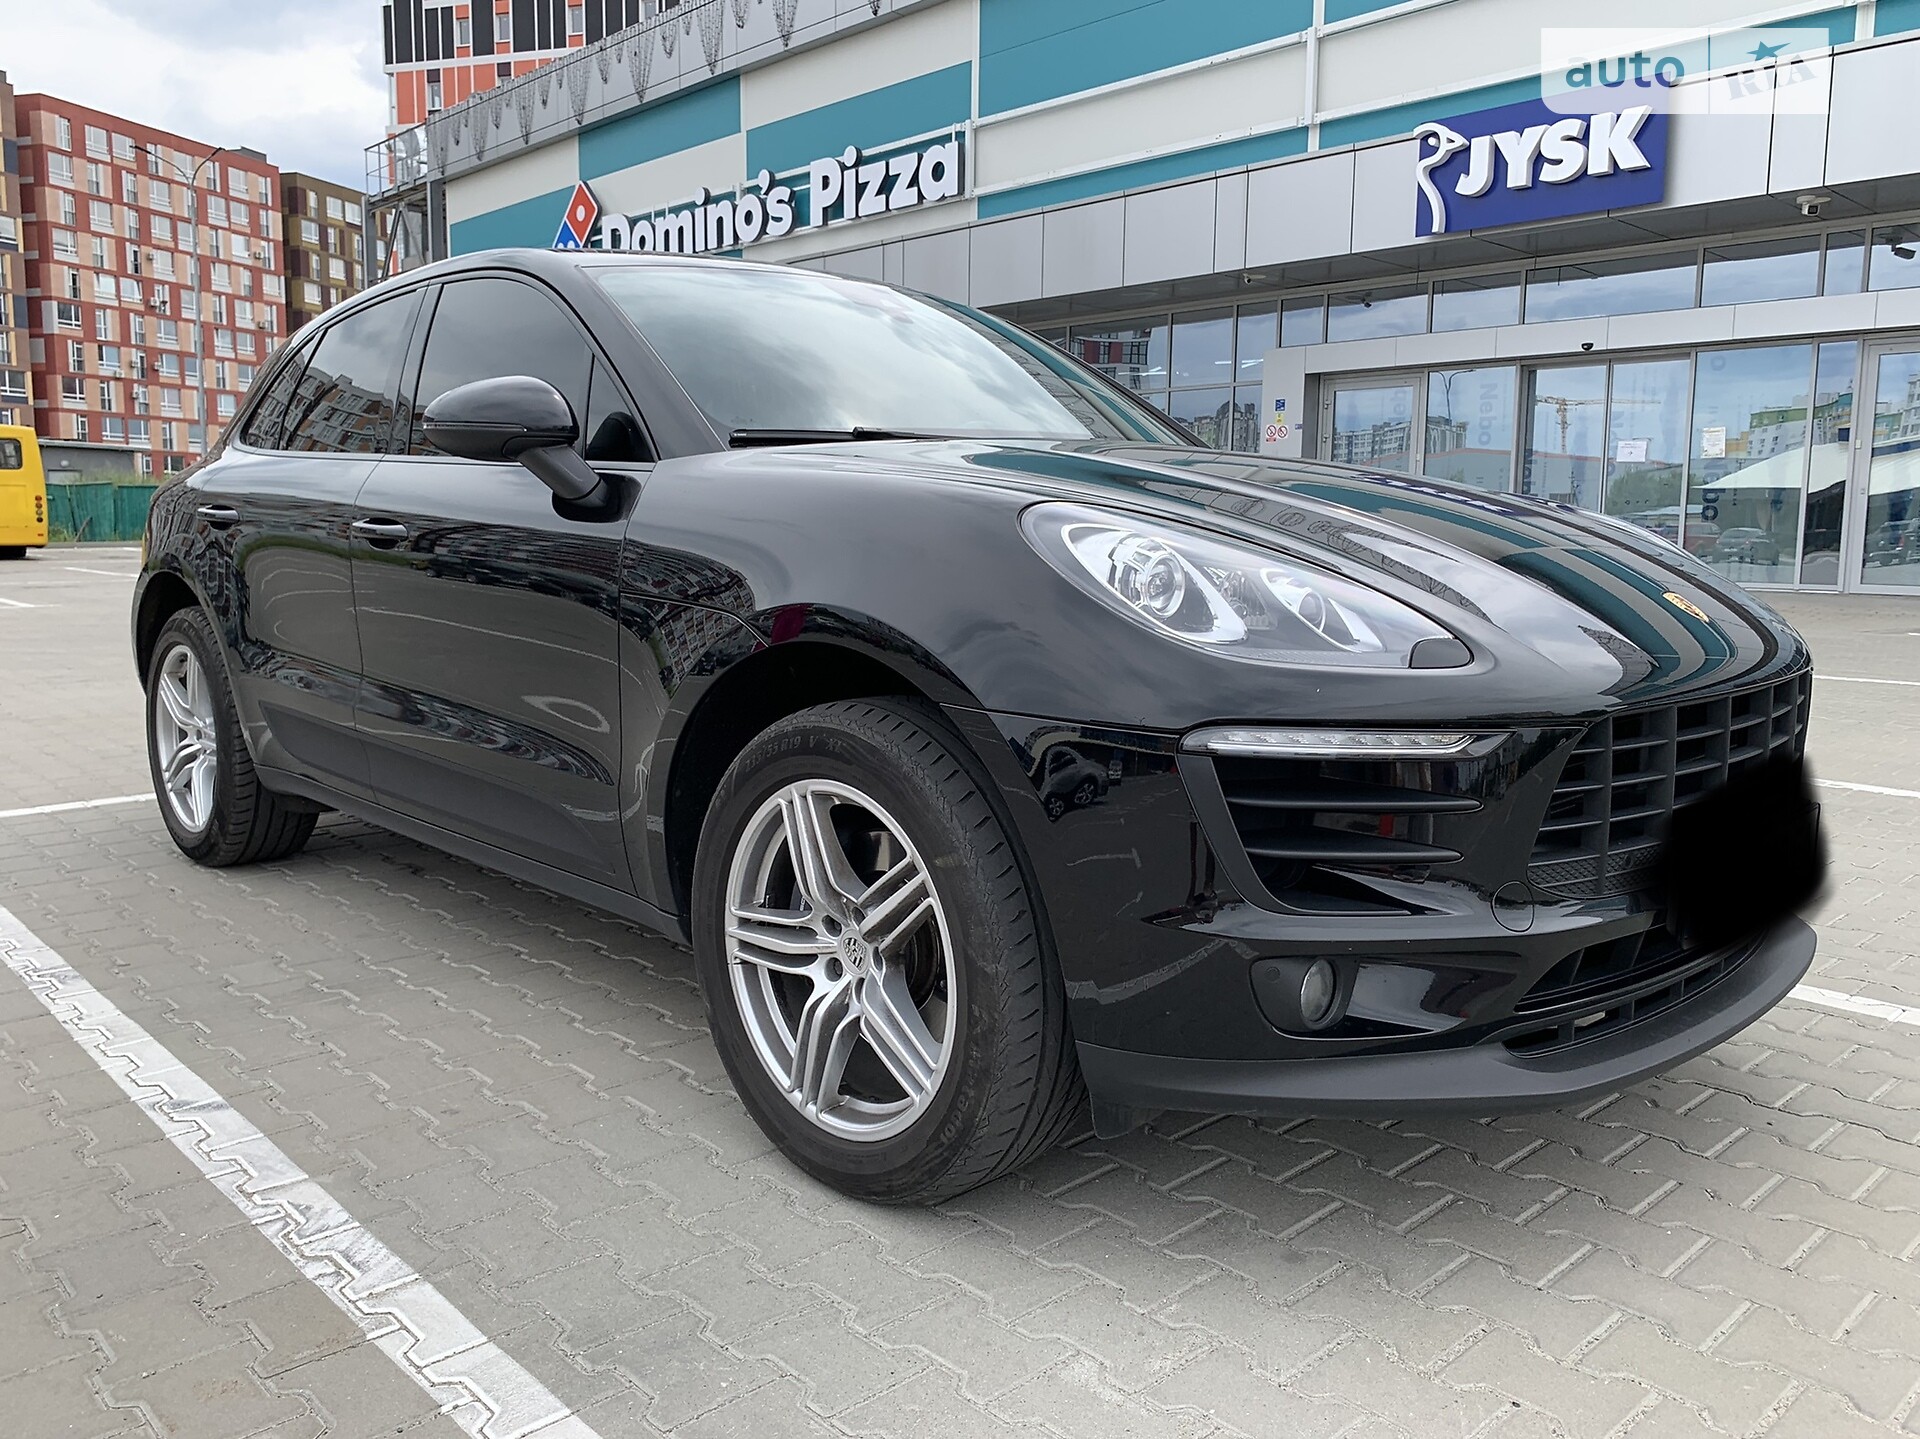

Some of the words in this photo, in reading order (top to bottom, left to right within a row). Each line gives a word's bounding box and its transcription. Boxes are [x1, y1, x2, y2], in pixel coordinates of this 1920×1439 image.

[602, 169, 796, 254] Domino's
[810, 141, 965, 227] Pizza
[1455, 105, 1653, 197] JYSK
